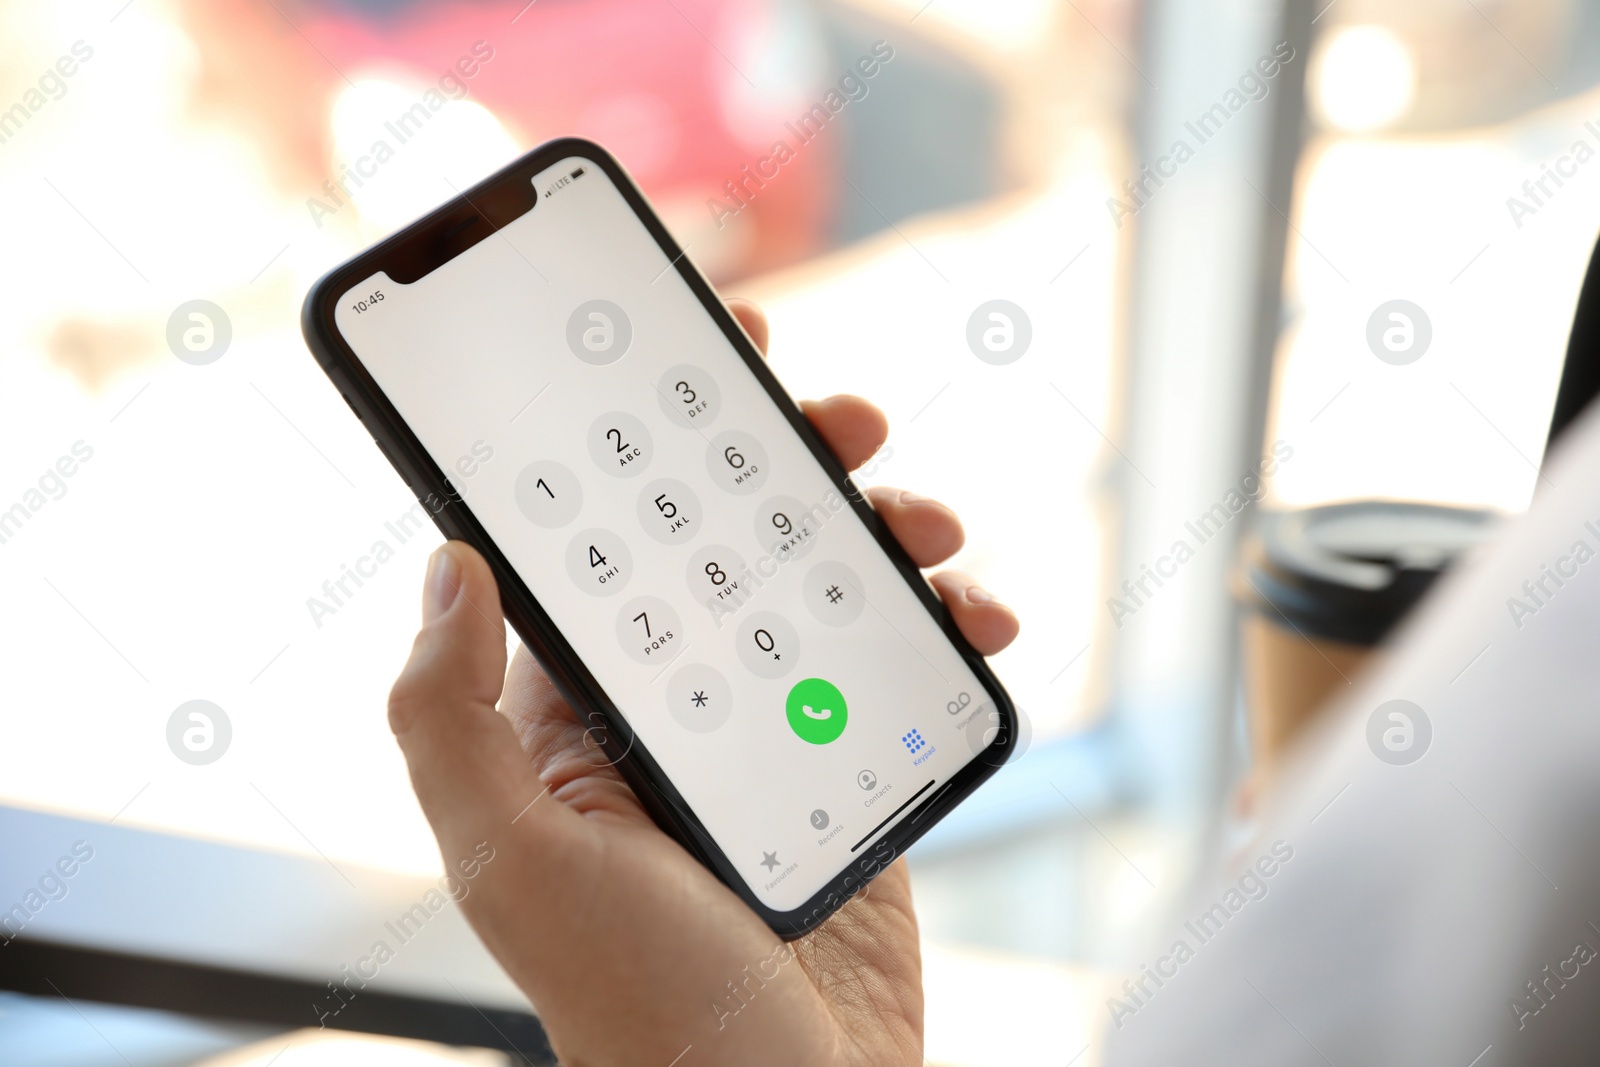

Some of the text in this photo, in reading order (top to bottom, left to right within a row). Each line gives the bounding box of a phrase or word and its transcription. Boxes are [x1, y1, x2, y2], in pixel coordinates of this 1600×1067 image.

[555, 176, 570, 189] LTE
[352, 290, 384, 314] 10:45
[675, 381, 696, 404] 3
[688, 400, 708, 418] DEF
[606, 428, 629, 453] 2
[619, 448, 641, 466] ABC
[725, 446, 745, 469] 6
[735, 465, 758, 485] MNO
[536, 478, 555, 499] 1
[654, 493, 677, 518] 5
[670, 516, 690, 533] JKL
[772, 512, 792, 535] 9
[780, 528, 810, 552] WXYZ
[588, 545, 606, 568] 4
[598, 566, 619, 584] GHI
[705, 562, 726, 585] 8
[716, 581, 738, 600] TUV
[825, 585, 843, 604] #
[633, 612, 651, 638] 7
[644, 631, 674, 655] PQRS
[754, 629, 774, 652] 0
[913, 746, 936, 767] Keypad
[864, 783, 892, 808] Contacts
[817, 824, 844, 847] Recents
[764, 862, 799, 892] Favourites
